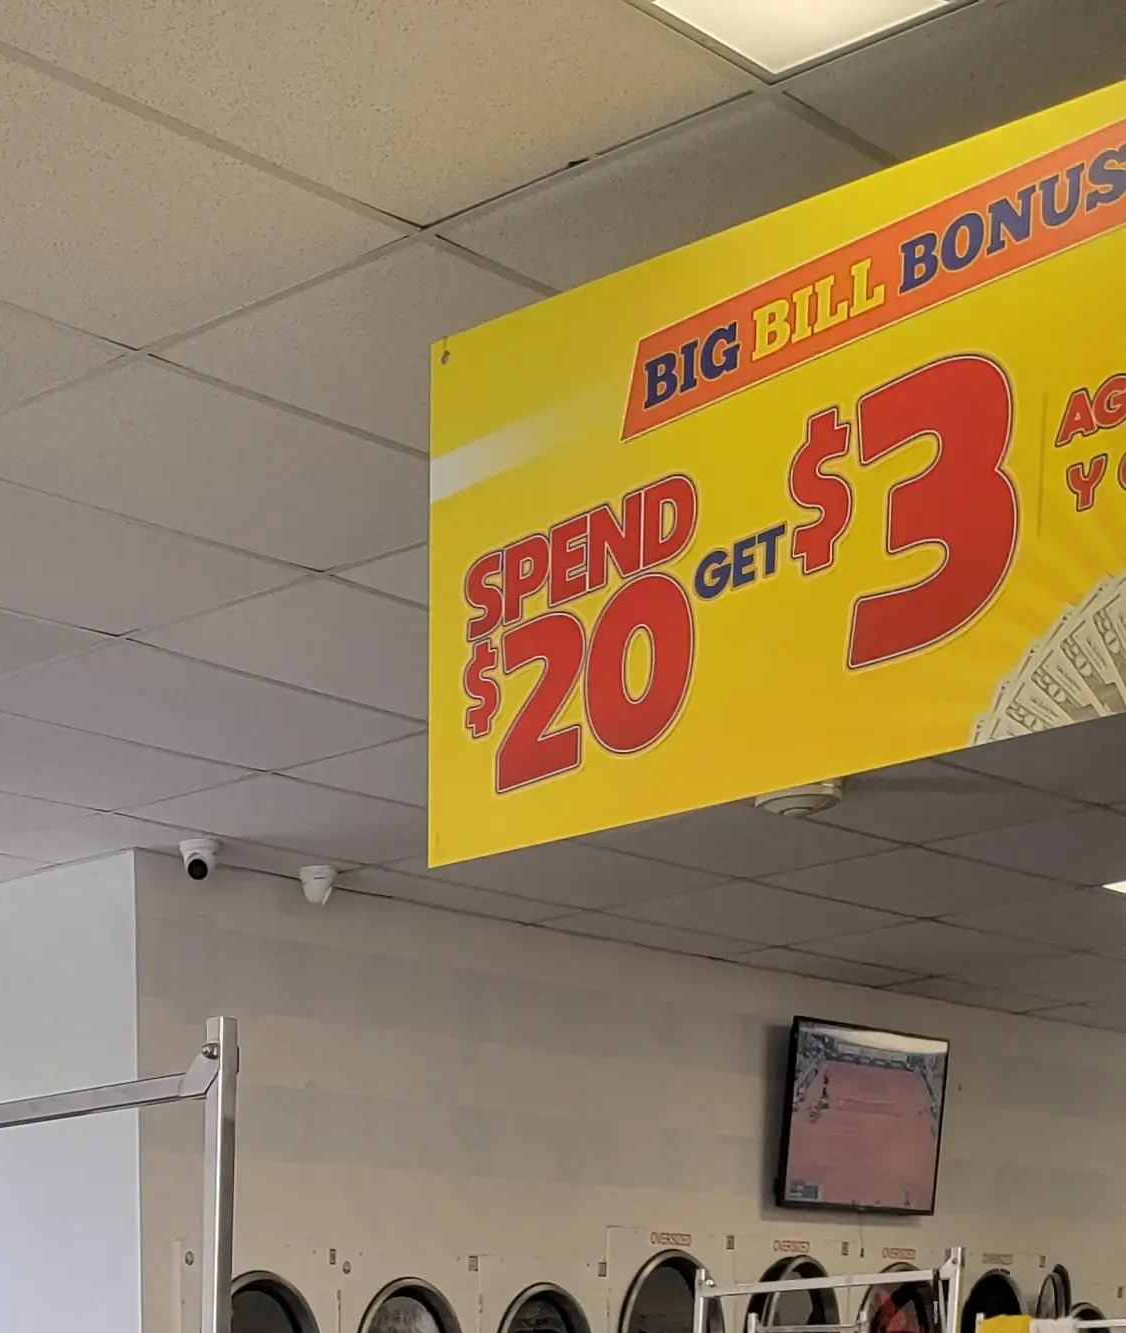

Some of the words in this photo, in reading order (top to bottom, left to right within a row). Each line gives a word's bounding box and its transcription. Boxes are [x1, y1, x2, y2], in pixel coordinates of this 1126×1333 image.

[643, 323, 740, 410] BIG
[751, 259, 886, 361] BILL
[898, 146, 1126, 294] BONUS
[464, 474, 697, 641] SPEND
[694, 522, 787, 600] GET
[788, 353, 1020, 669] $3
[464, 571, 696, 794] $20
